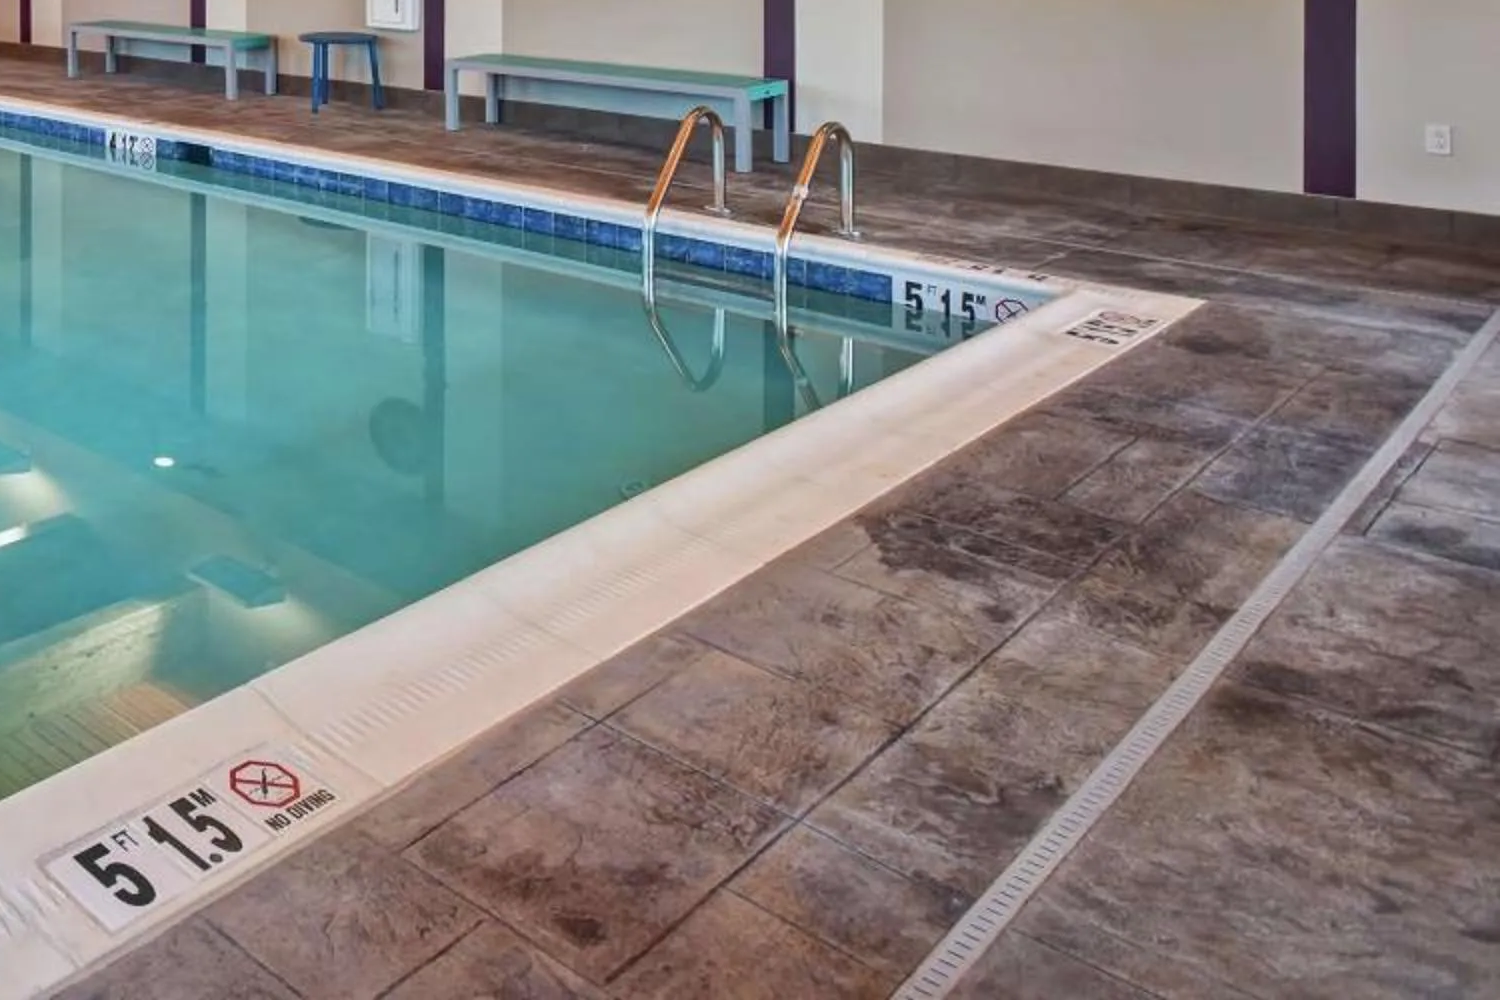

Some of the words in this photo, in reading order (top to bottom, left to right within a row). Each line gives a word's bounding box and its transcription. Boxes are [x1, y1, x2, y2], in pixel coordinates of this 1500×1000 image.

[905, 281, 923, 311] 5
[188, 787, 217, 808] M
[262, 813, 292, 831] NO
[285, 789, 336, 820] DIVING
[143, 797, 244, 872] 1.5
[73, 842, 157, 906] 5
